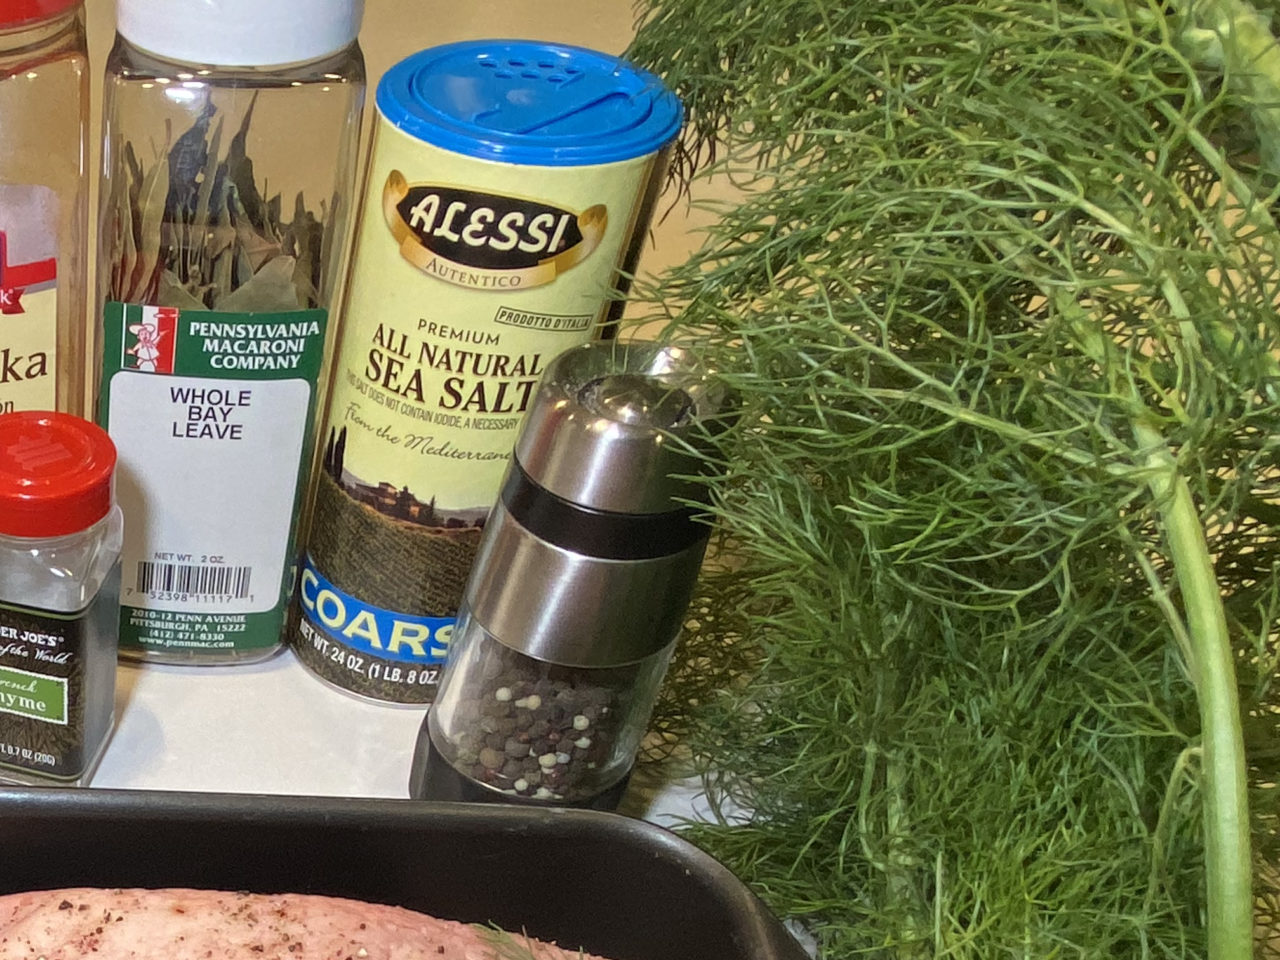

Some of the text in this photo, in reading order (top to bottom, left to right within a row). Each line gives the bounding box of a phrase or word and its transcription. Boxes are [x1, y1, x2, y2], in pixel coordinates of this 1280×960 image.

[408, 193, 571, 254] ALESSI
[498, 309, 552, 328] PRODOTTO
[189, 320, 321, 340] PENNSYLVANIA
[417, 318, 501, 347] PREMIUM
[202, 337, 306, 355] MACARONI
[372, 322, 545, 378] ALL NATURAL
[209, 353, 302, 371] COMPANY
[364, 348, 540, 414] SEA SALT
[170, 386, 253, 407] WHOLE
[187, 405, 234, 423] BAY
[367, 386, 385, 405] DOES
[384, 396, 400, 412] NOT
[400, 403, 433, 423] CONTAIN
[463, 416, 472, 429] A
[471, 416, 520, 431] NECESSARY
[172, 421, 244, 441] LEAVE
[344, 401, 375, 433] From
[375, 425, 402, 445] the
[153, 551, 174, 561] NET
[200, 554, 209, 563] 2
[131, 609, 247, 624] 2010-12 PENN AVENUE
[300, 567, 456, 659] COARS
[149, 629, 225, 642] (412) 471-8330
[194, 624, 209, 632] PA
[216, 623, 246, 632] 15222
[20, 631, 58, 648] JOE'S
[138, 635, 236, 649] www.pennmac.com
[10, 644, 29, 658] the
[34, 647, 74, 665] World
[299, 617, 313, 638] NET
[330, 646, 346, 666] 24
[406, 668, 418, 684] 8
[7, 743, 21, 756] 0.7
[22, 747, 33, 760] OZ
[34, 750, 57, 767] (20G)
